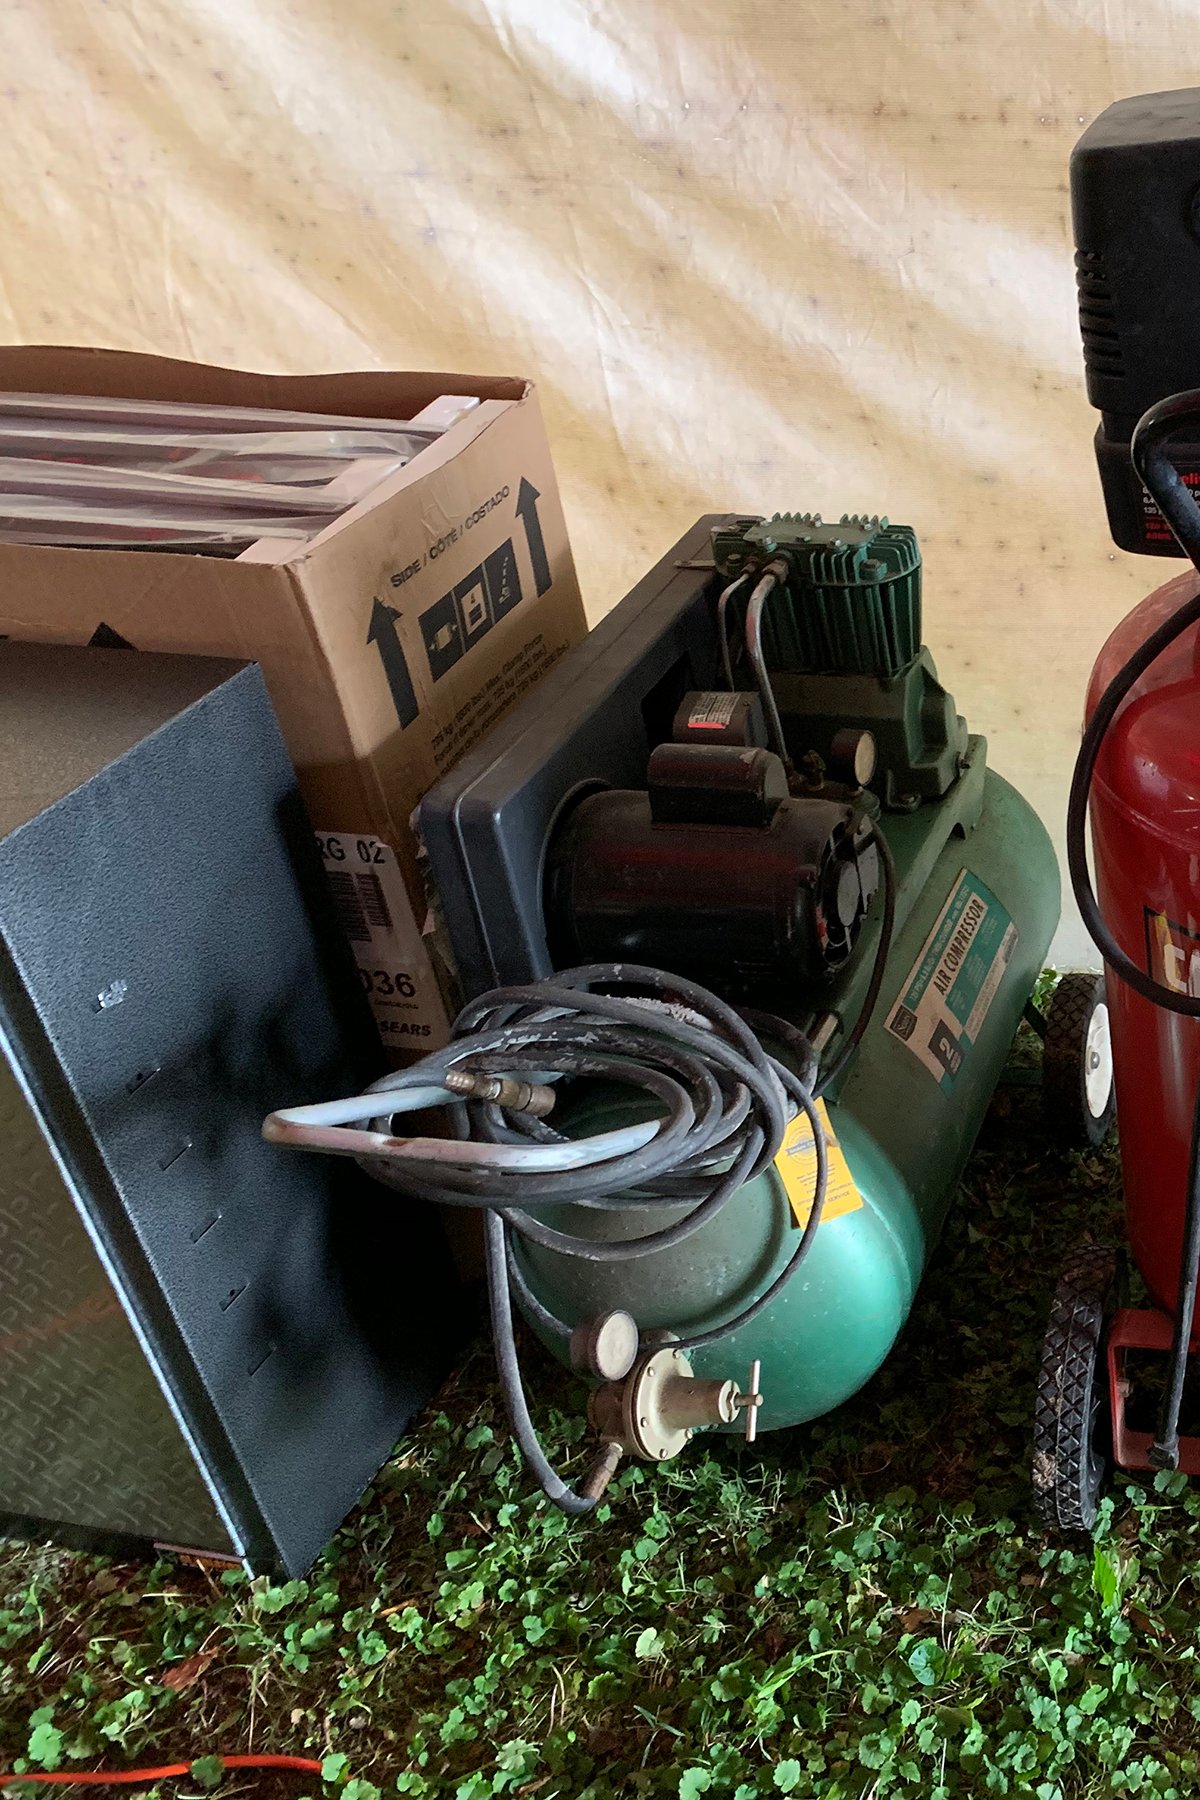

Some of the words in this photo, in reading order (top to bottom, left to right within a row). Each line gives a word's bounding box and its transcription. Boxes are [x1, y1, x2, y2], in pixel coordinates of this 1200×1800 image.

[390, 558, 421, 588] SIDE
[465, 485, 510, 530] COSTADO
[356, 839, 385, 864] 02
[933, 968, 952, 996] AIR
[947, 898, 985, 978] COMPRESSOR
[380, 1020, 432, 1037] SEARS
[939, 1036, 953, 1061] 2
